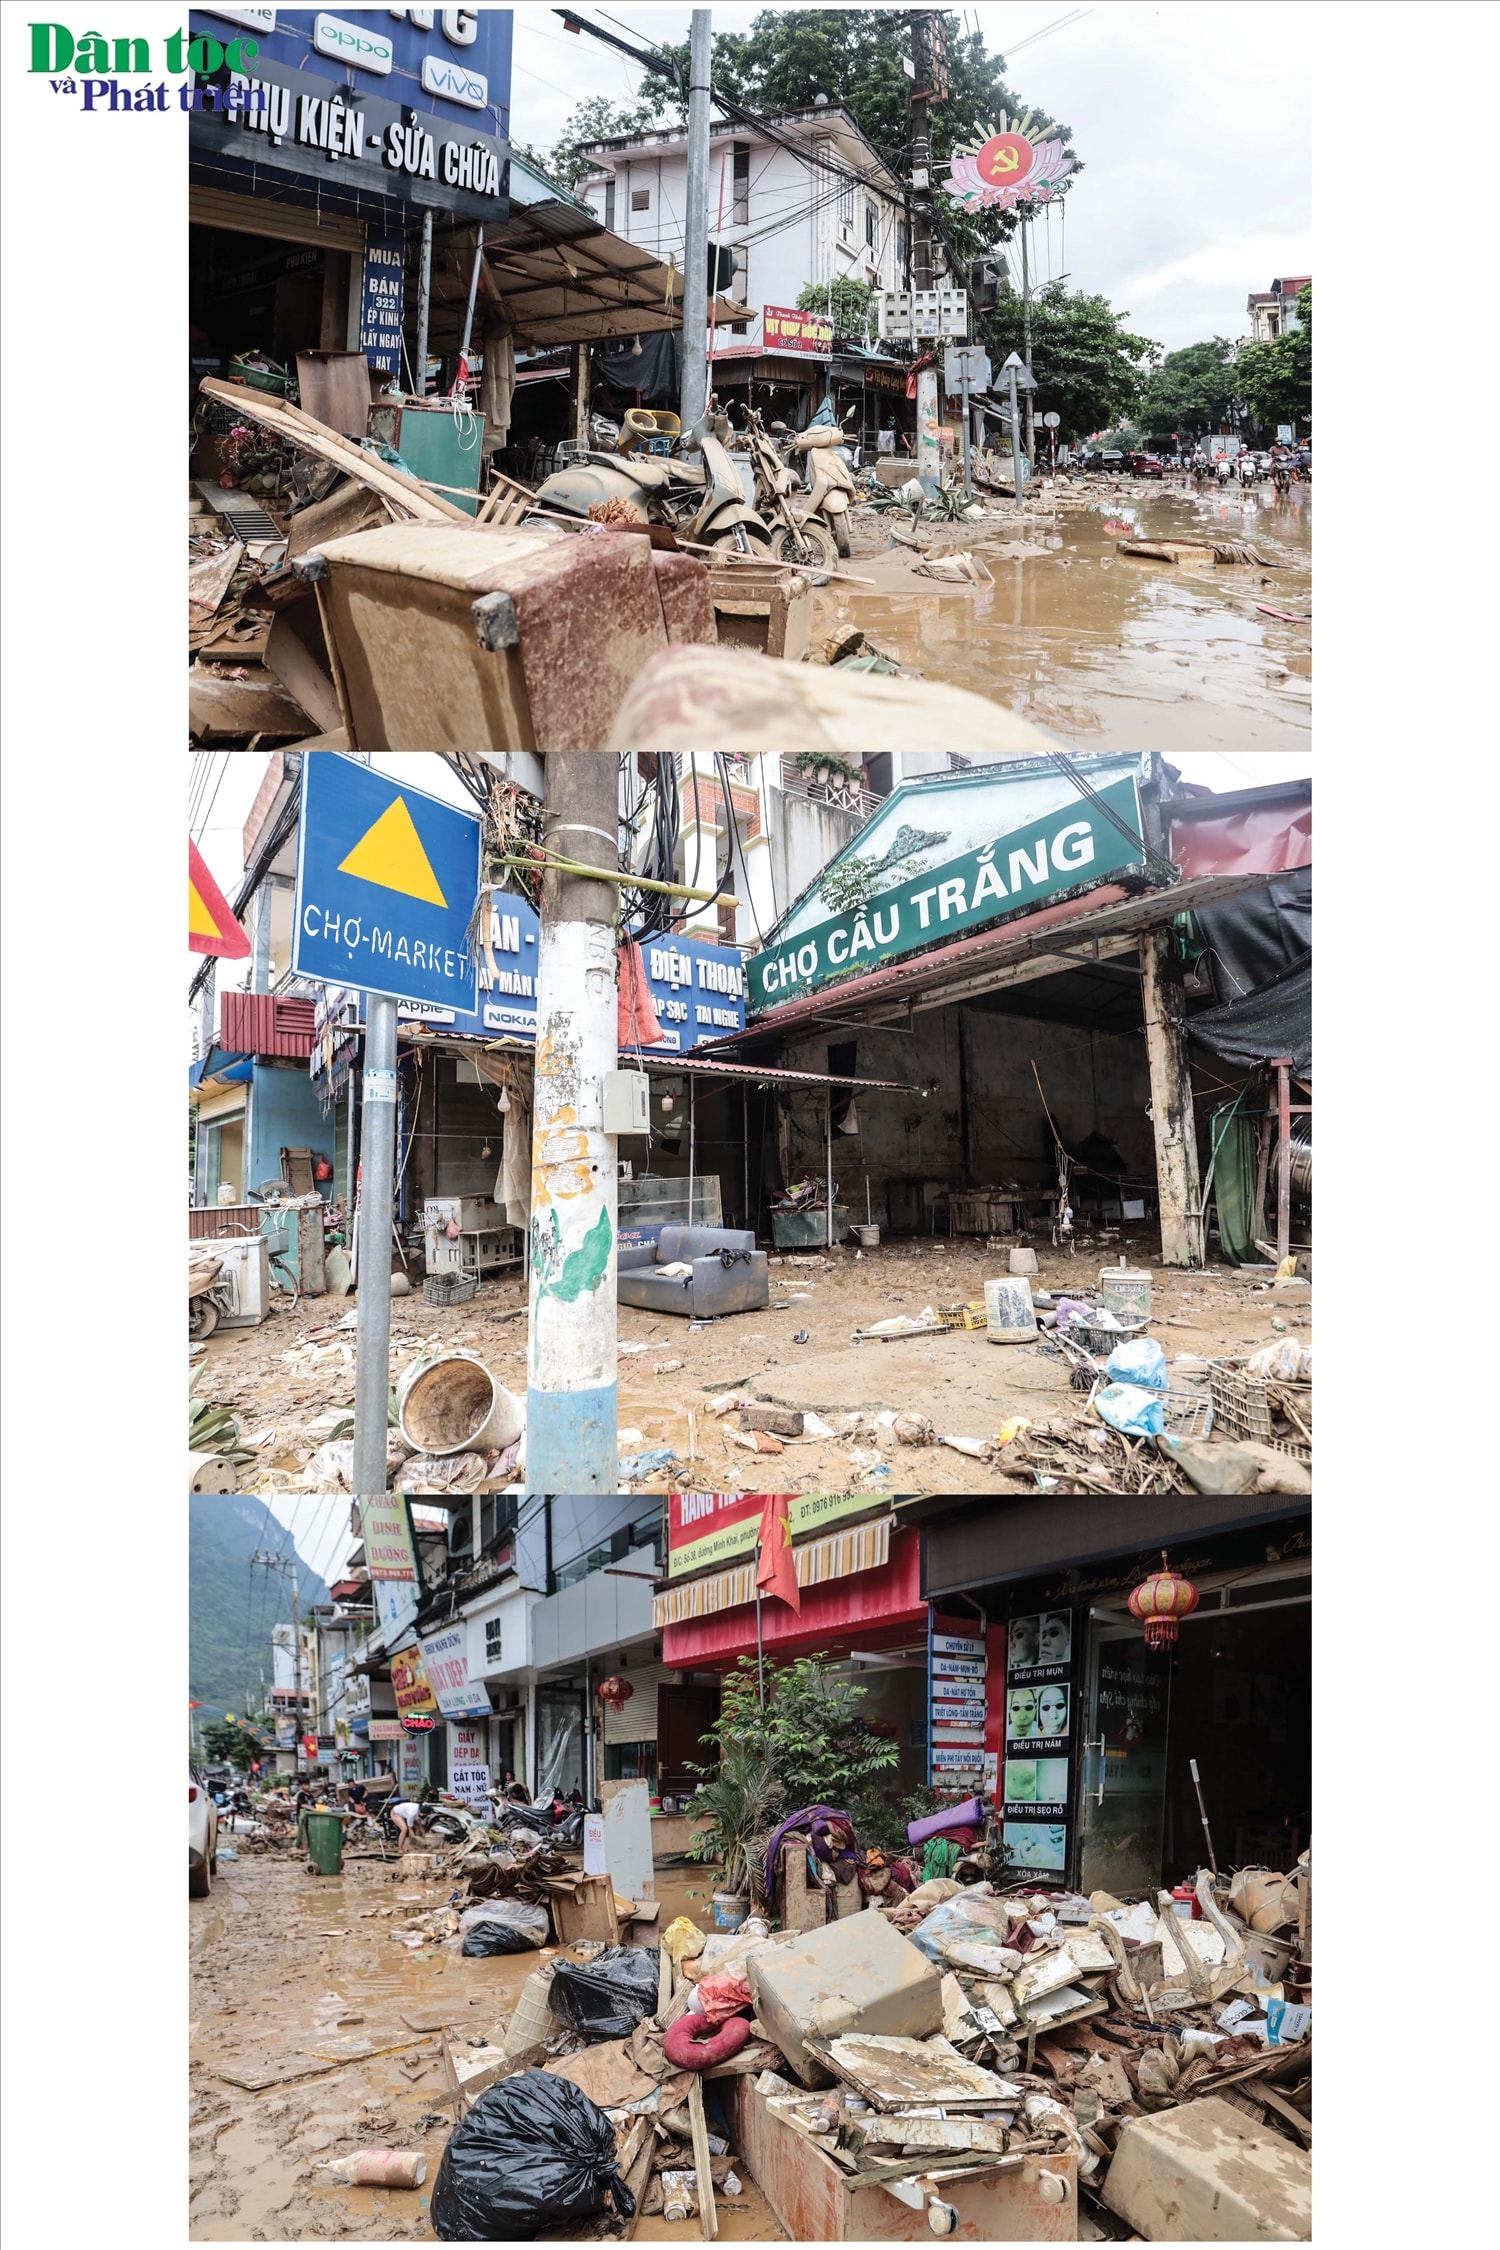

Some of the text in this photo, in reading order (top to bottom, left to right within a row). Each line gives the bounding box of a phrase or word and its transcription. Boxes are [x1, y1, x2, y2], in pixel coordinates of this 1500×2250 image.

[320, 26, 390, 59] oppo
[430, 68, 484, 99] vivo
[228, 73, 291, 146] PHỤ
[300, 94, 365, 160] KIỆN
[387, 111, 436, 179] SỬA
[444, 141, 500, 197] CHỮA
[369, 247, 401, 267] MUA
[369, 276, 399, 296] BÁN
[375, 298, 396, 309] 322
[367, 306, 377, 325] ÉP
[363, 328, 400, 349] LẤY NGAY
[376, 355, 391, 370] HAY
[762, 821, 1096, 993] CHỢ CẦU TRẮNG
[479, 905, 520, 953] ÁN
[303, 904, 468, 980] CHỢ-MARKET
[650, 946, 693, 991] ĐIỆN
[696, 958, 743, 1003] THOẠI
[488, 1011, 537, 1027] NOKIA
[652, 994, 739, 1029] ÁP SẠC TAI NGHE
[812, 1496, 829, 1514] 0976
[713, 1538, 726, 1552] Minh
[1033, 1669, 1045, 1679] TRỊ
[1046, 1666, 1064, 1677] MỤN
[1031, 1741, 1043, 1751] TRỊ
[453, 1768, 487, 1782] CẮT TÓC
[454, 1784, 472, 1794] NAM
[1024, 1806, 1036, 1816] TRỊ
[1036, 1806, 1052, 1816] SẸO
